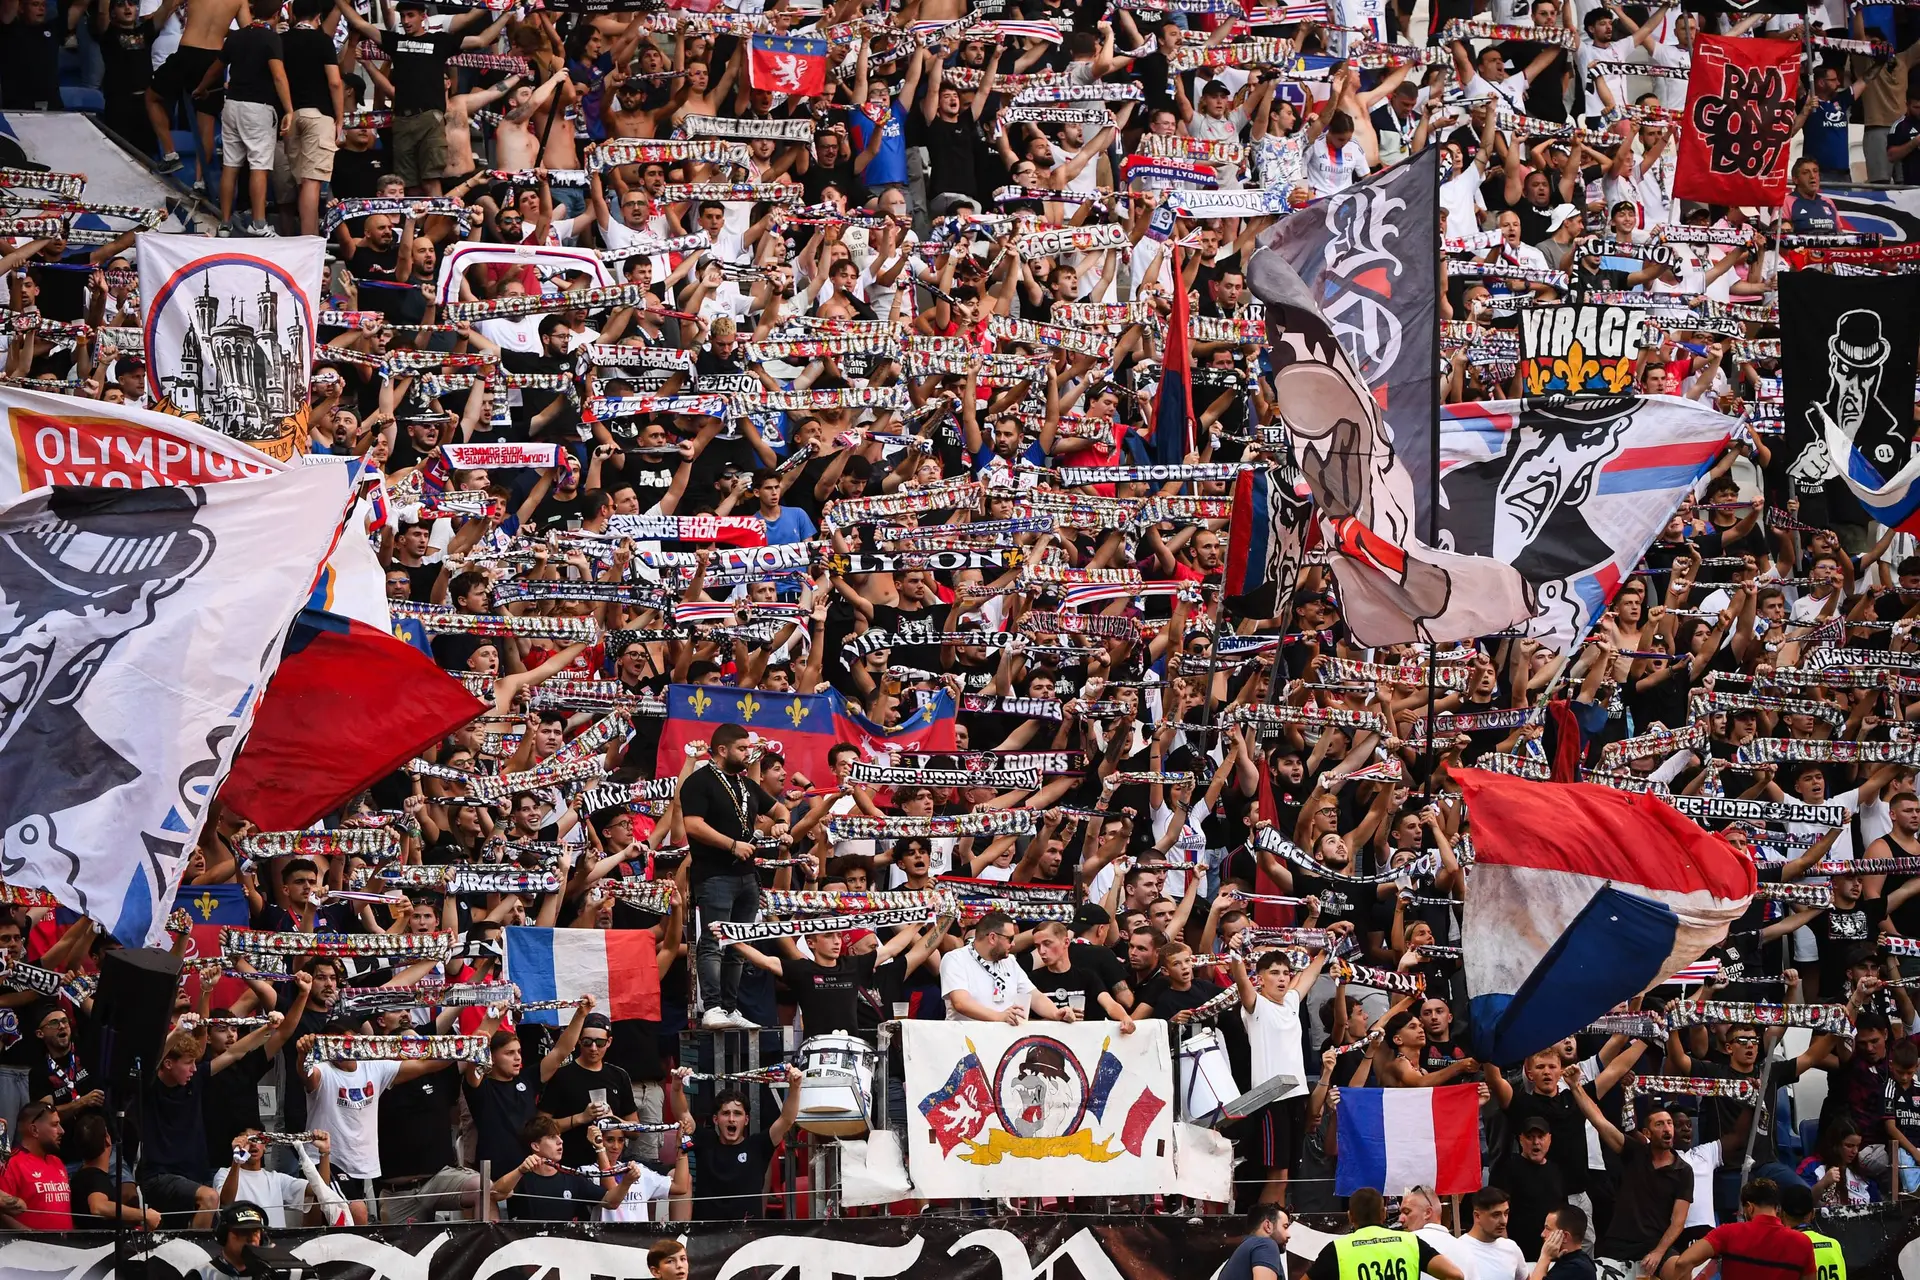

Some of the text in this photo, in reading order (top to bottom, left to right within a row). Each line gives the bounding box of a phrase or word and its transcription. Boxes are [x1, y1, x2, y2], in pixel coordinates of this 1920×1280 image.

[1213, 0, 1240, 15] LYO
[1723, 63, 1785, 100] BAD
[1692, 94, 1796, 144] GONES
[785, 120, 811, 139] LYO
[1127, 165, 1174, 178] OLYMPIQUE
[1152, 157, 1195, 171] adidas
[1091, 223, 1126, 247] NO
[1666, 233, 1746, 247] OLYMPIQUE LYONNAIS
[324, 311, 344, 326] OL
[1522, 306, 1647, 360] VIRAGE
[640, 348, 692, 365] GERLA
[641, 358, 689, 371] LYONNAIS
[849, 367, 864, 375] ETTER
[1060, 464, 1193, 488] VIRAGE NORD
[1017, 516, 1053, 532] LYO
[721, 541, 810, 577] LYON
[843, 631, 1030, 658] VIRAGE NOR
[1218, 637, 1259, 651] ONNAIS
[1002, 696, 1063, 721] GONES
[1477, 709, 1520, 729] NORD
[1262, 730, 1279, 738] ETTER
[1004, 753, 1068, 773] GONES
[1710, 798, 1763, 819] NORD
[1791, 803, 1843, 828] LYON
[448, 870, 560, 892] VIRAGE NO
[1889, 938, 1920, 958] BA
[1787, 1003, 1845, 1031] NOR
[431, 1035, 490, 1062] NOR
[1357, 1258, 1408, 1280] 0346
